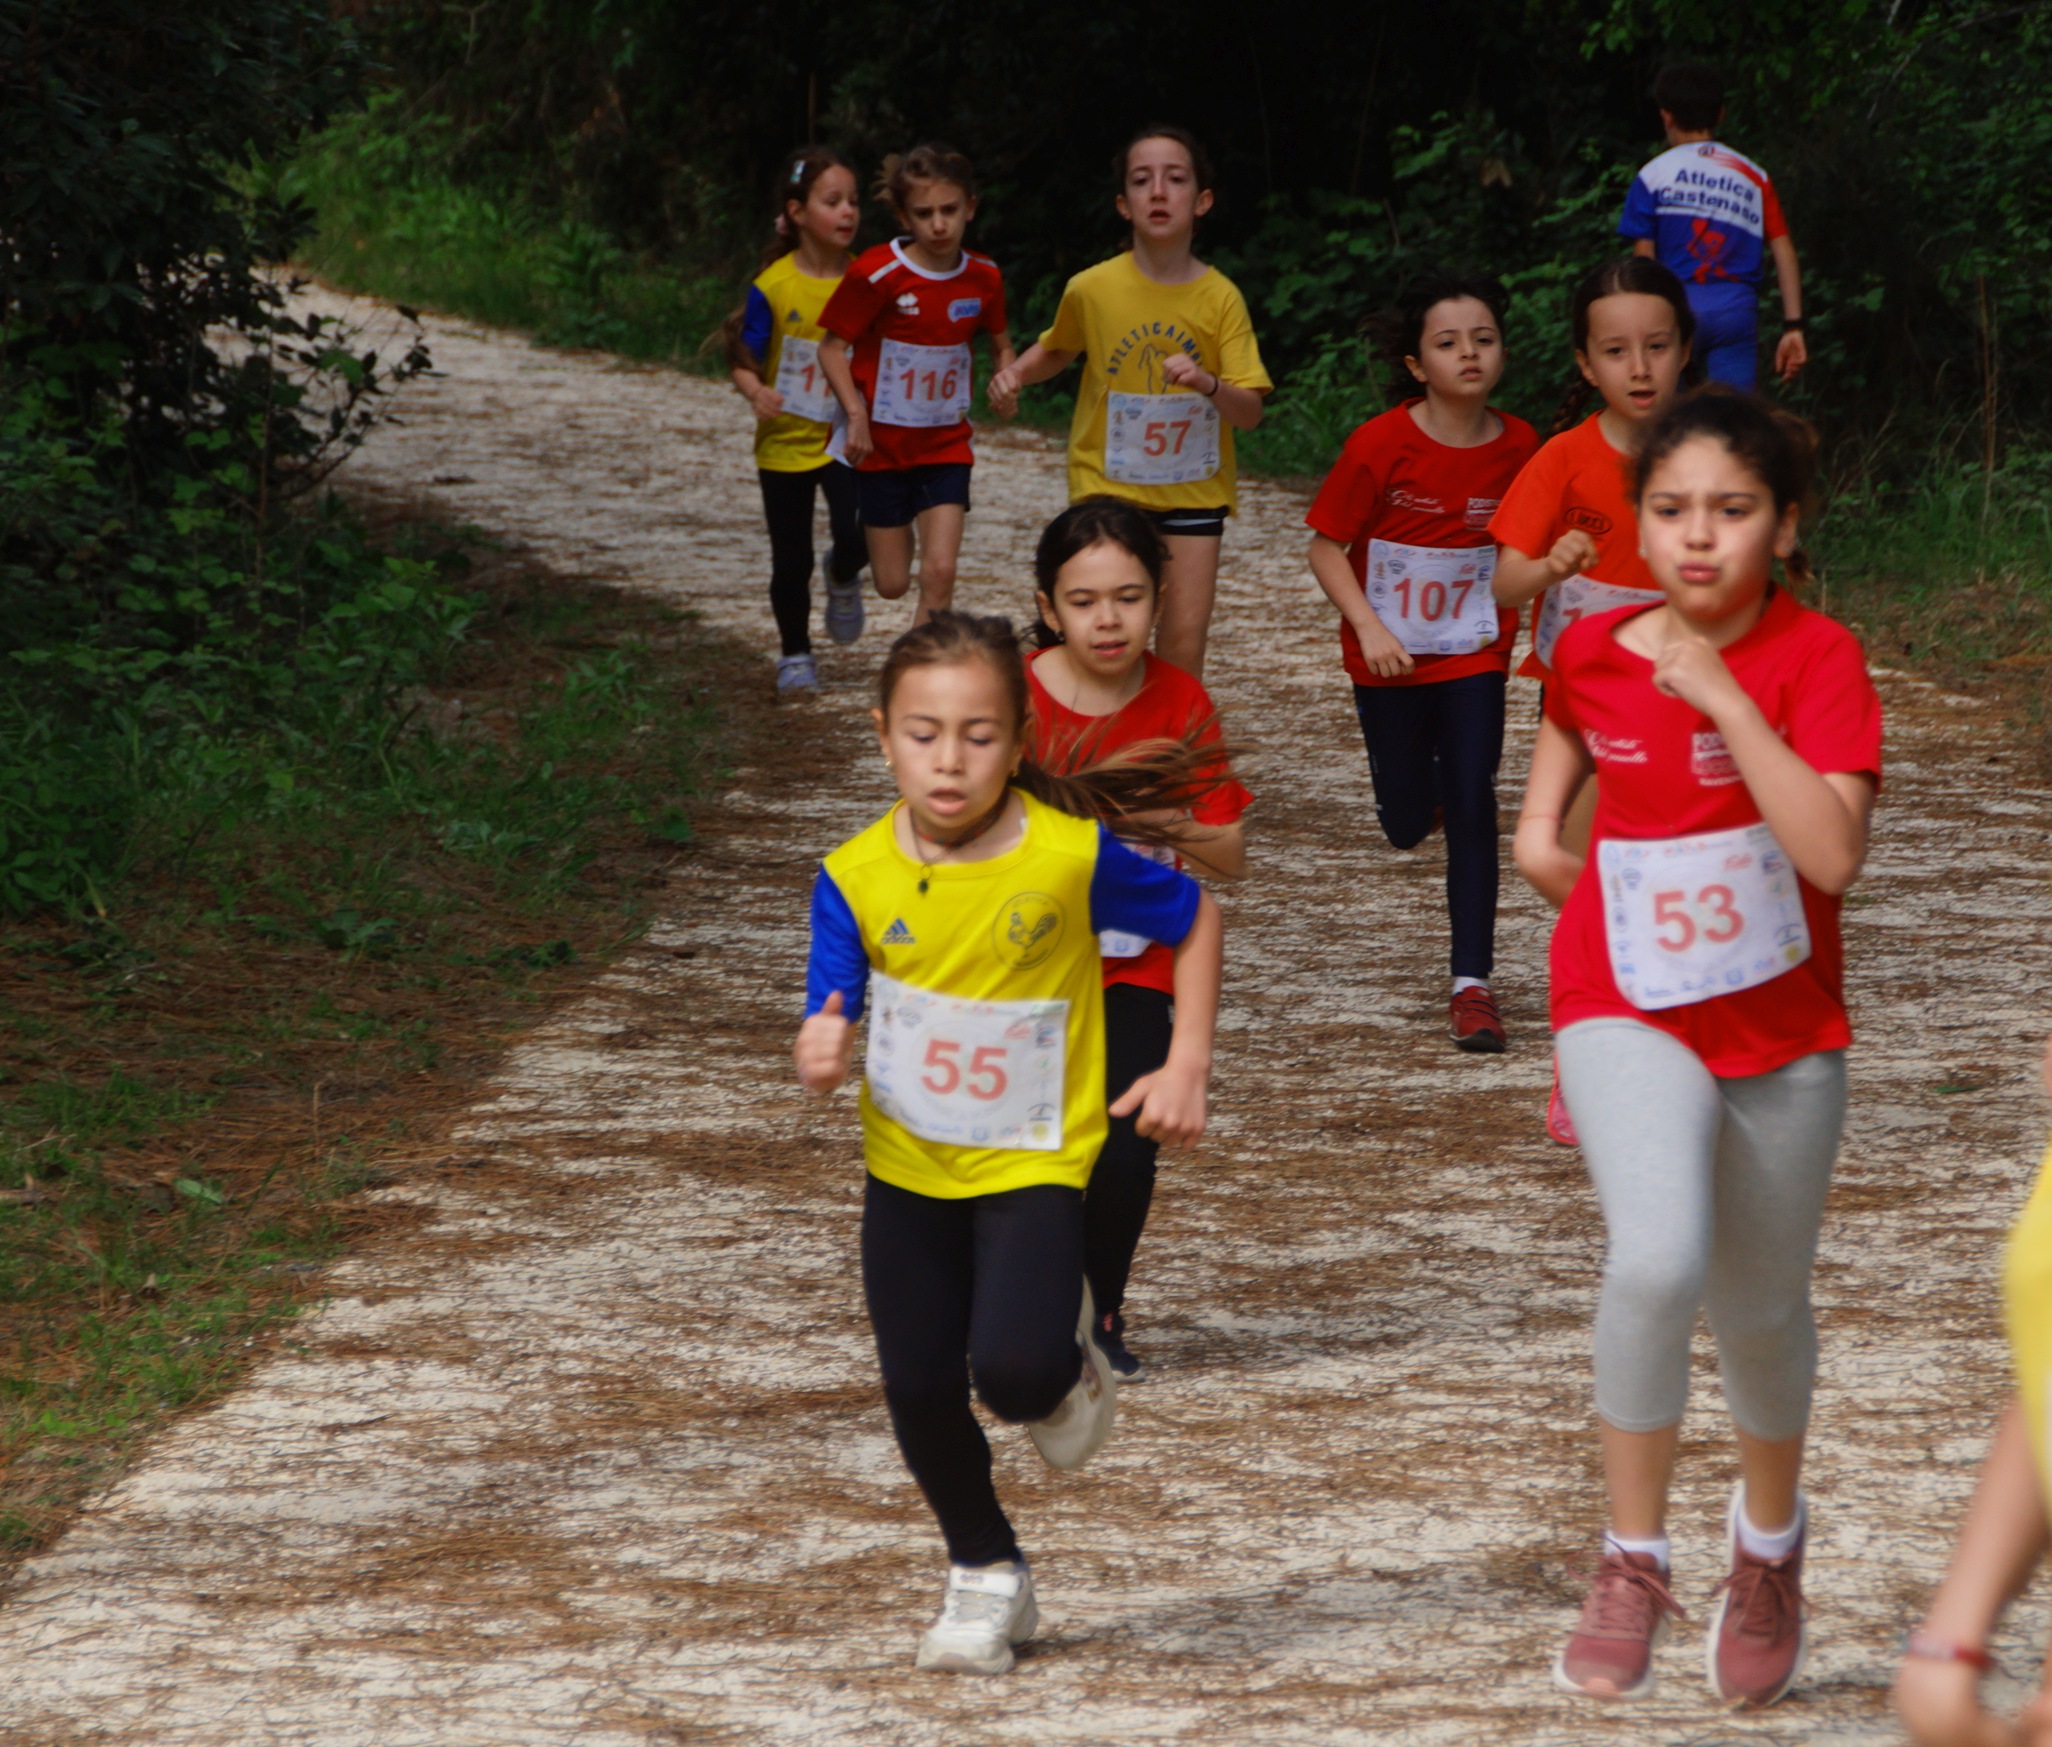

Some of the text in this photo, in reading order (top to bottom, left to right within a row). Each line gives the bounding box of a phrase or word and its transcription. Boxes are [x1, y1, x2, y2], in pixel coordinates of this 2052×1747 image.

[1675, 169, 1755, 202] Atletica
[1659, 187, 1760, 225] Castenaso
[900, 368, 958, 401] 116
[1143, 420, 1193, 456] 57
[1393, 577, 1475, 621] 107
[1654, 884, 1745, 952] 53
[920, 1039, 1008, 1100] 55
